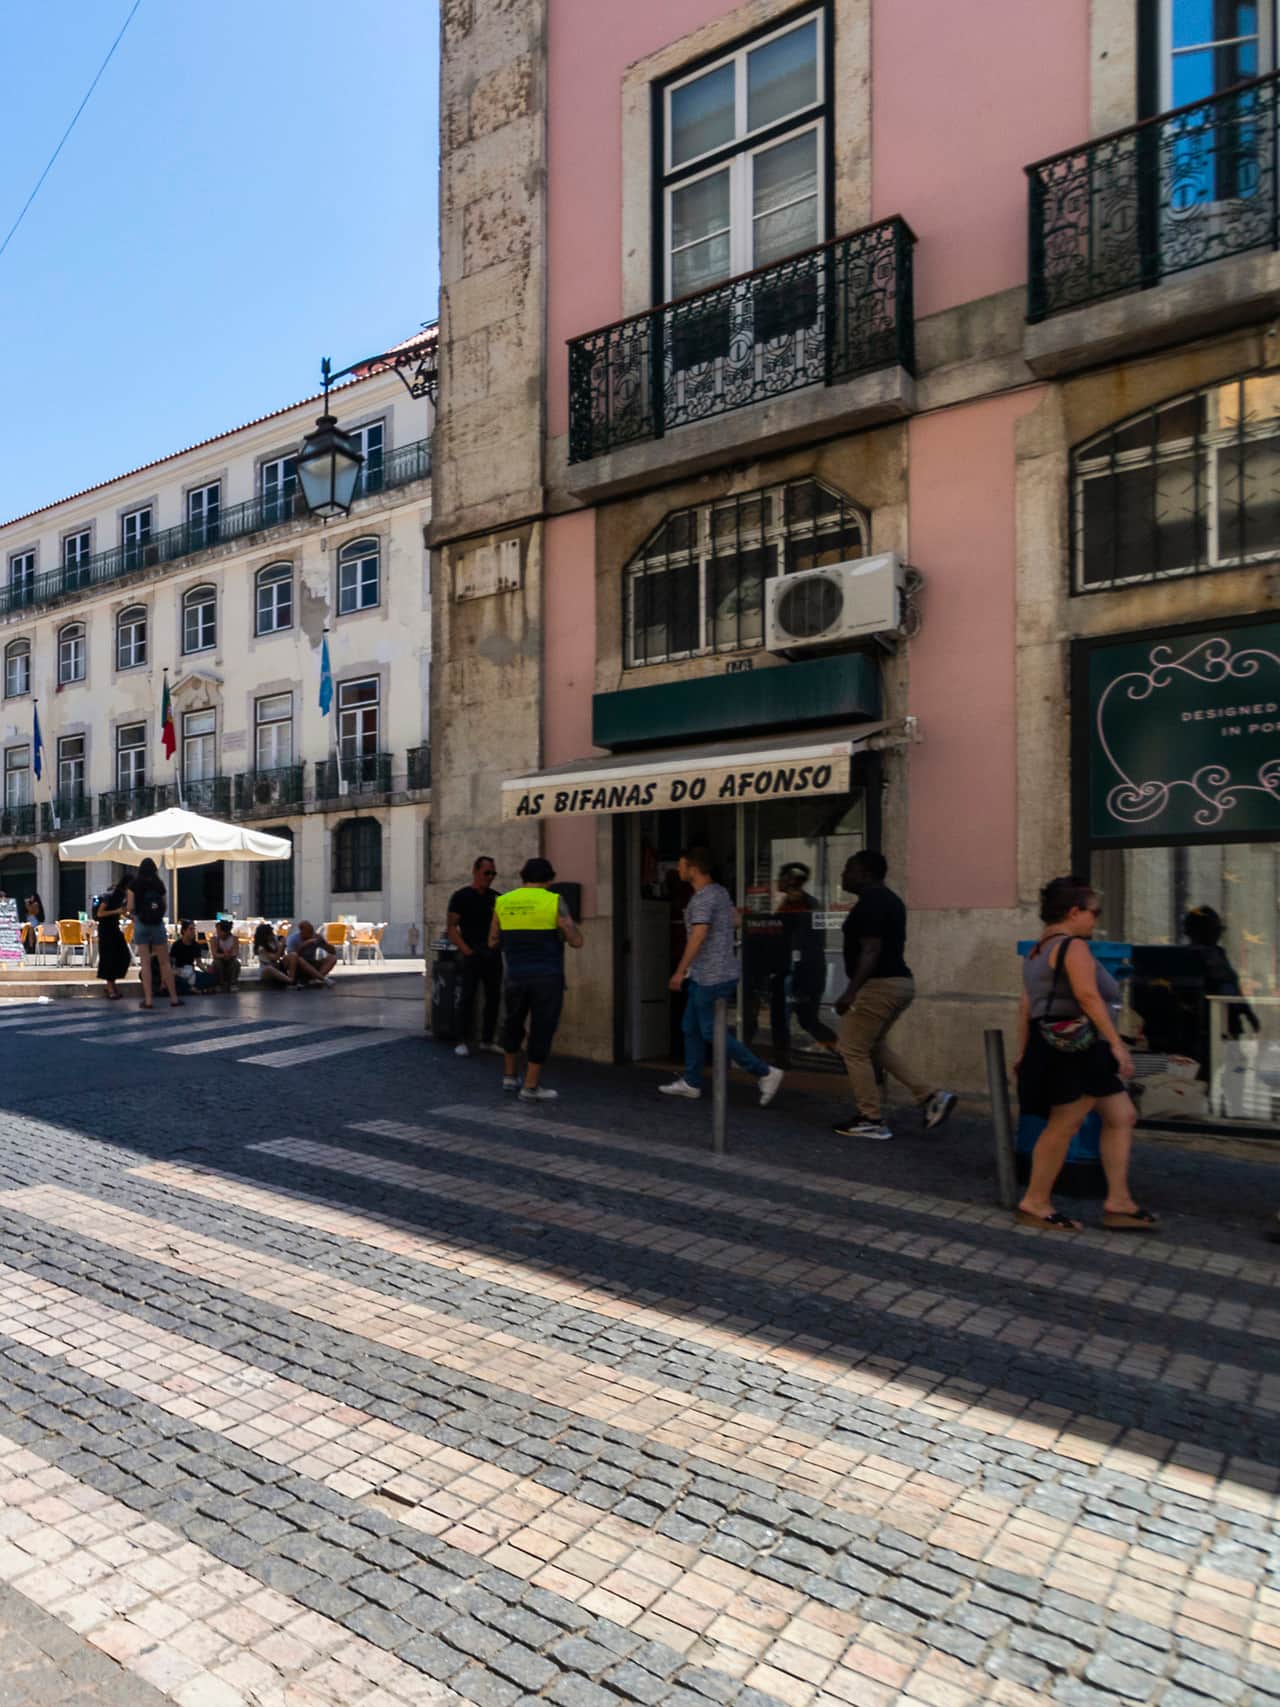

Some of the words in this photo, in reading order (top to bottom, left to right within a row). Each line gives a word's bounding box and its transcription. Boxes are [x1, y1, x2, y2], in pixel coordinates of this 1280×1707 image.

[1181, 702, 1277, 721] DESIGNED
[1221, 726, 1241, 736] IN
[516, 794, 545, 817] AS
[554, 782, 657, 813] BIFANAS
[671, 777, 706, 802] DO
[719, 764, 832, 799] AFONSO
